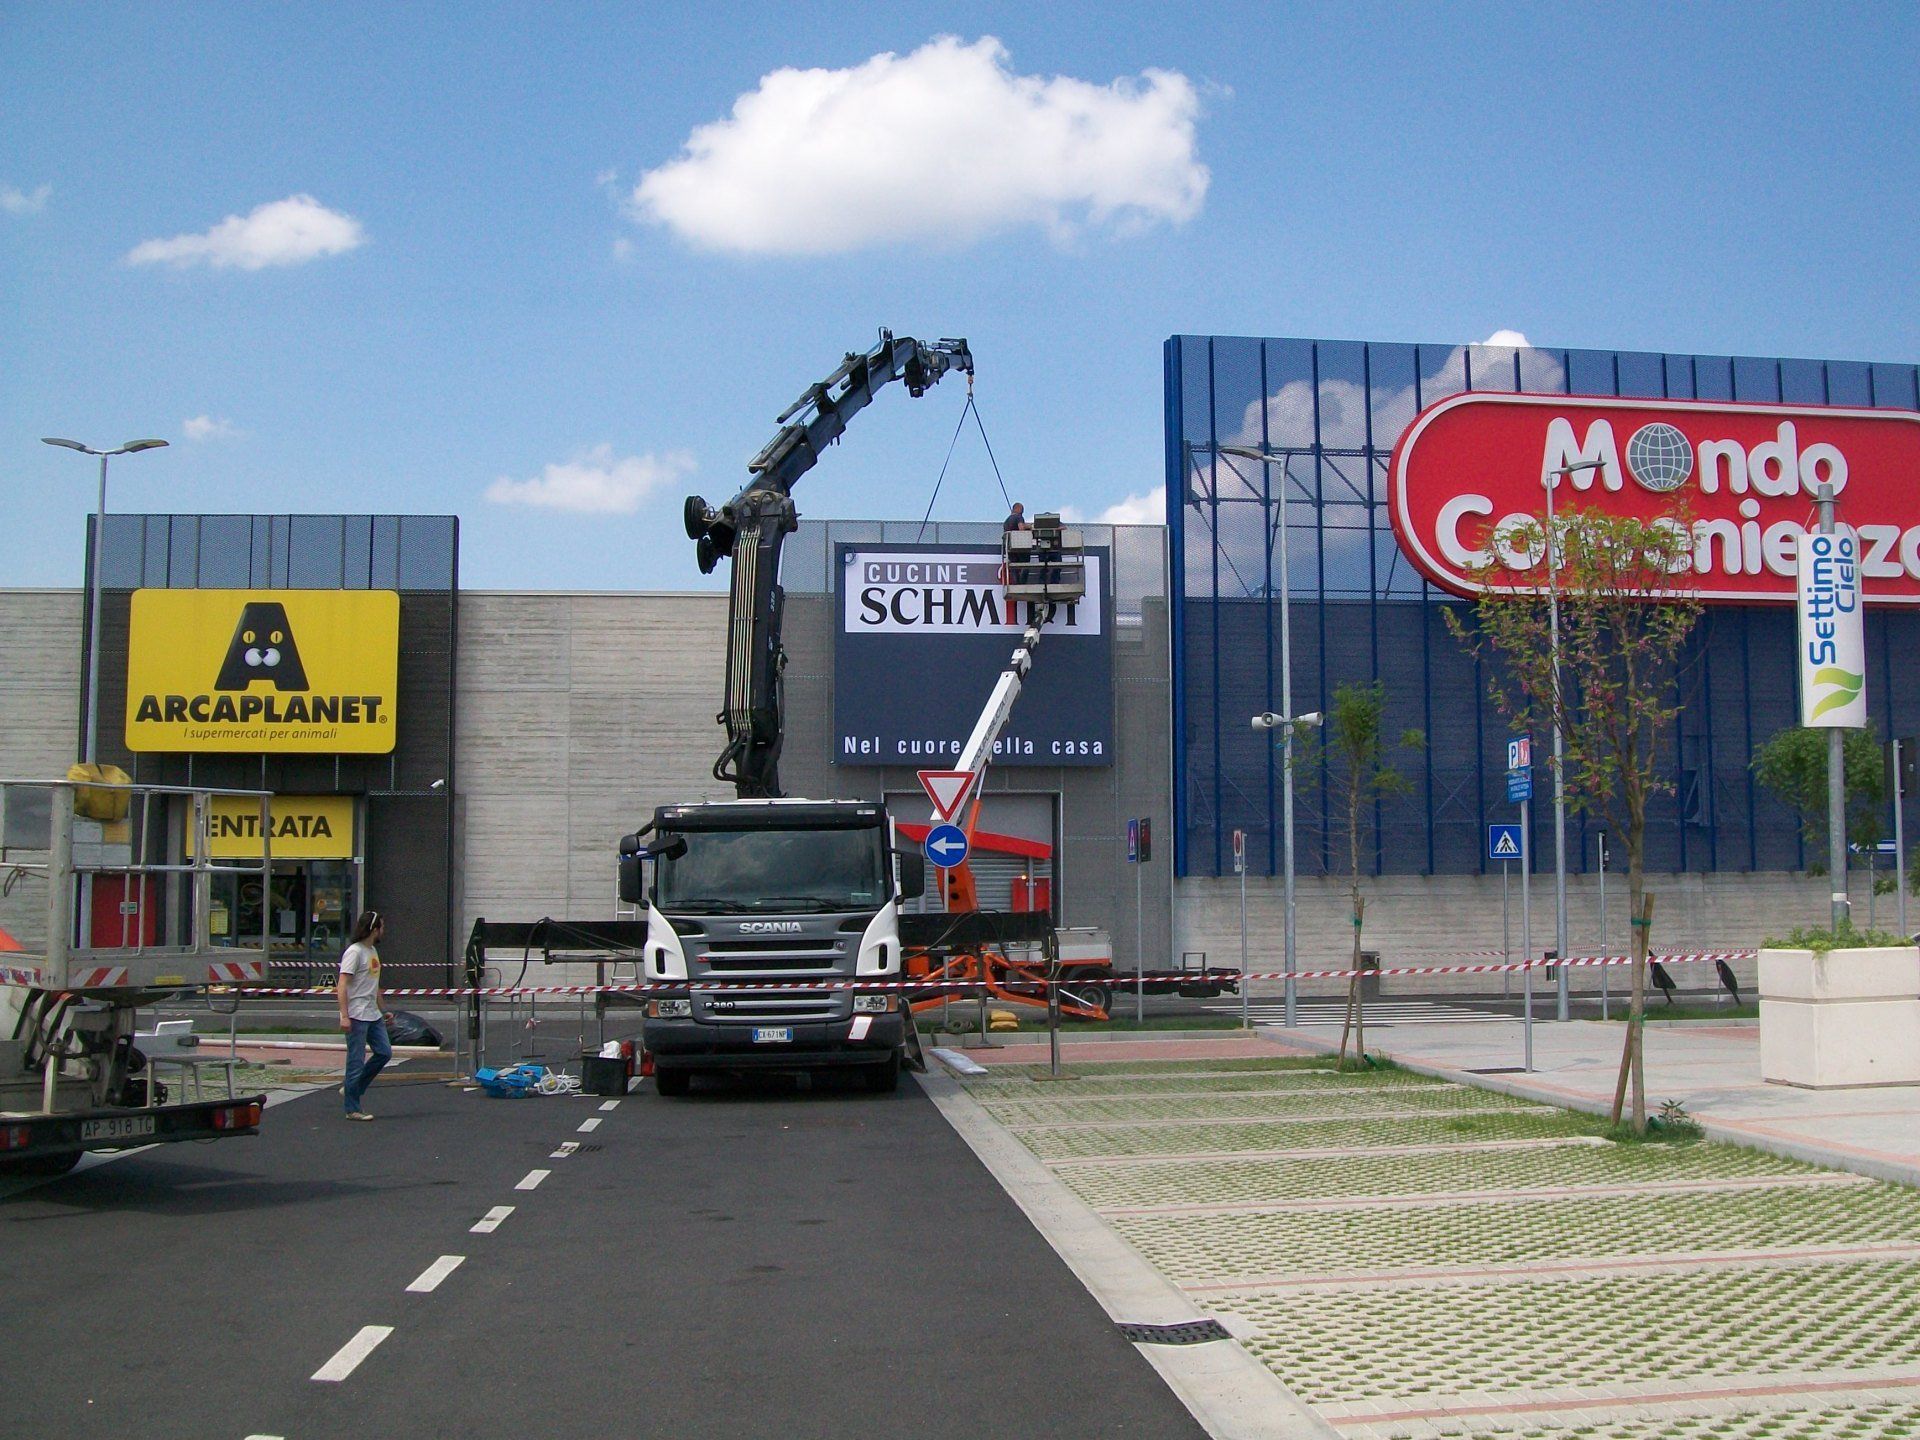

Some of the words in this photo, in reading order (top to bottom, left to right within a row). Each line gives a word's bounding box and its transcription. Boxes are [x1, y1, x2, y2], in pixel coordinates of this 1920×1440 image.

[1541, 417, 1848, 498] Mondo
[1435, 494, 1920, 580] Coneniez
[868, 564, 968, 583] CUCINE
[1834, 538, 1855, 613] Cielo
[1807, 537, 1836, 665] Settimo
[190, 728, 267, 741] supermercati
[269, 731, 289, 741] per
[291, 728, 337, 739] animali
[844, 736, 880, 754] Nel
[897, 740, 961, 754] cuore
[993, 736, 1034, 754] ella
[1051, 740, 1104, 755] casa
[206, 815, 332, 838] ENTRATA
[738, 922, 803, 934] SCANIA
